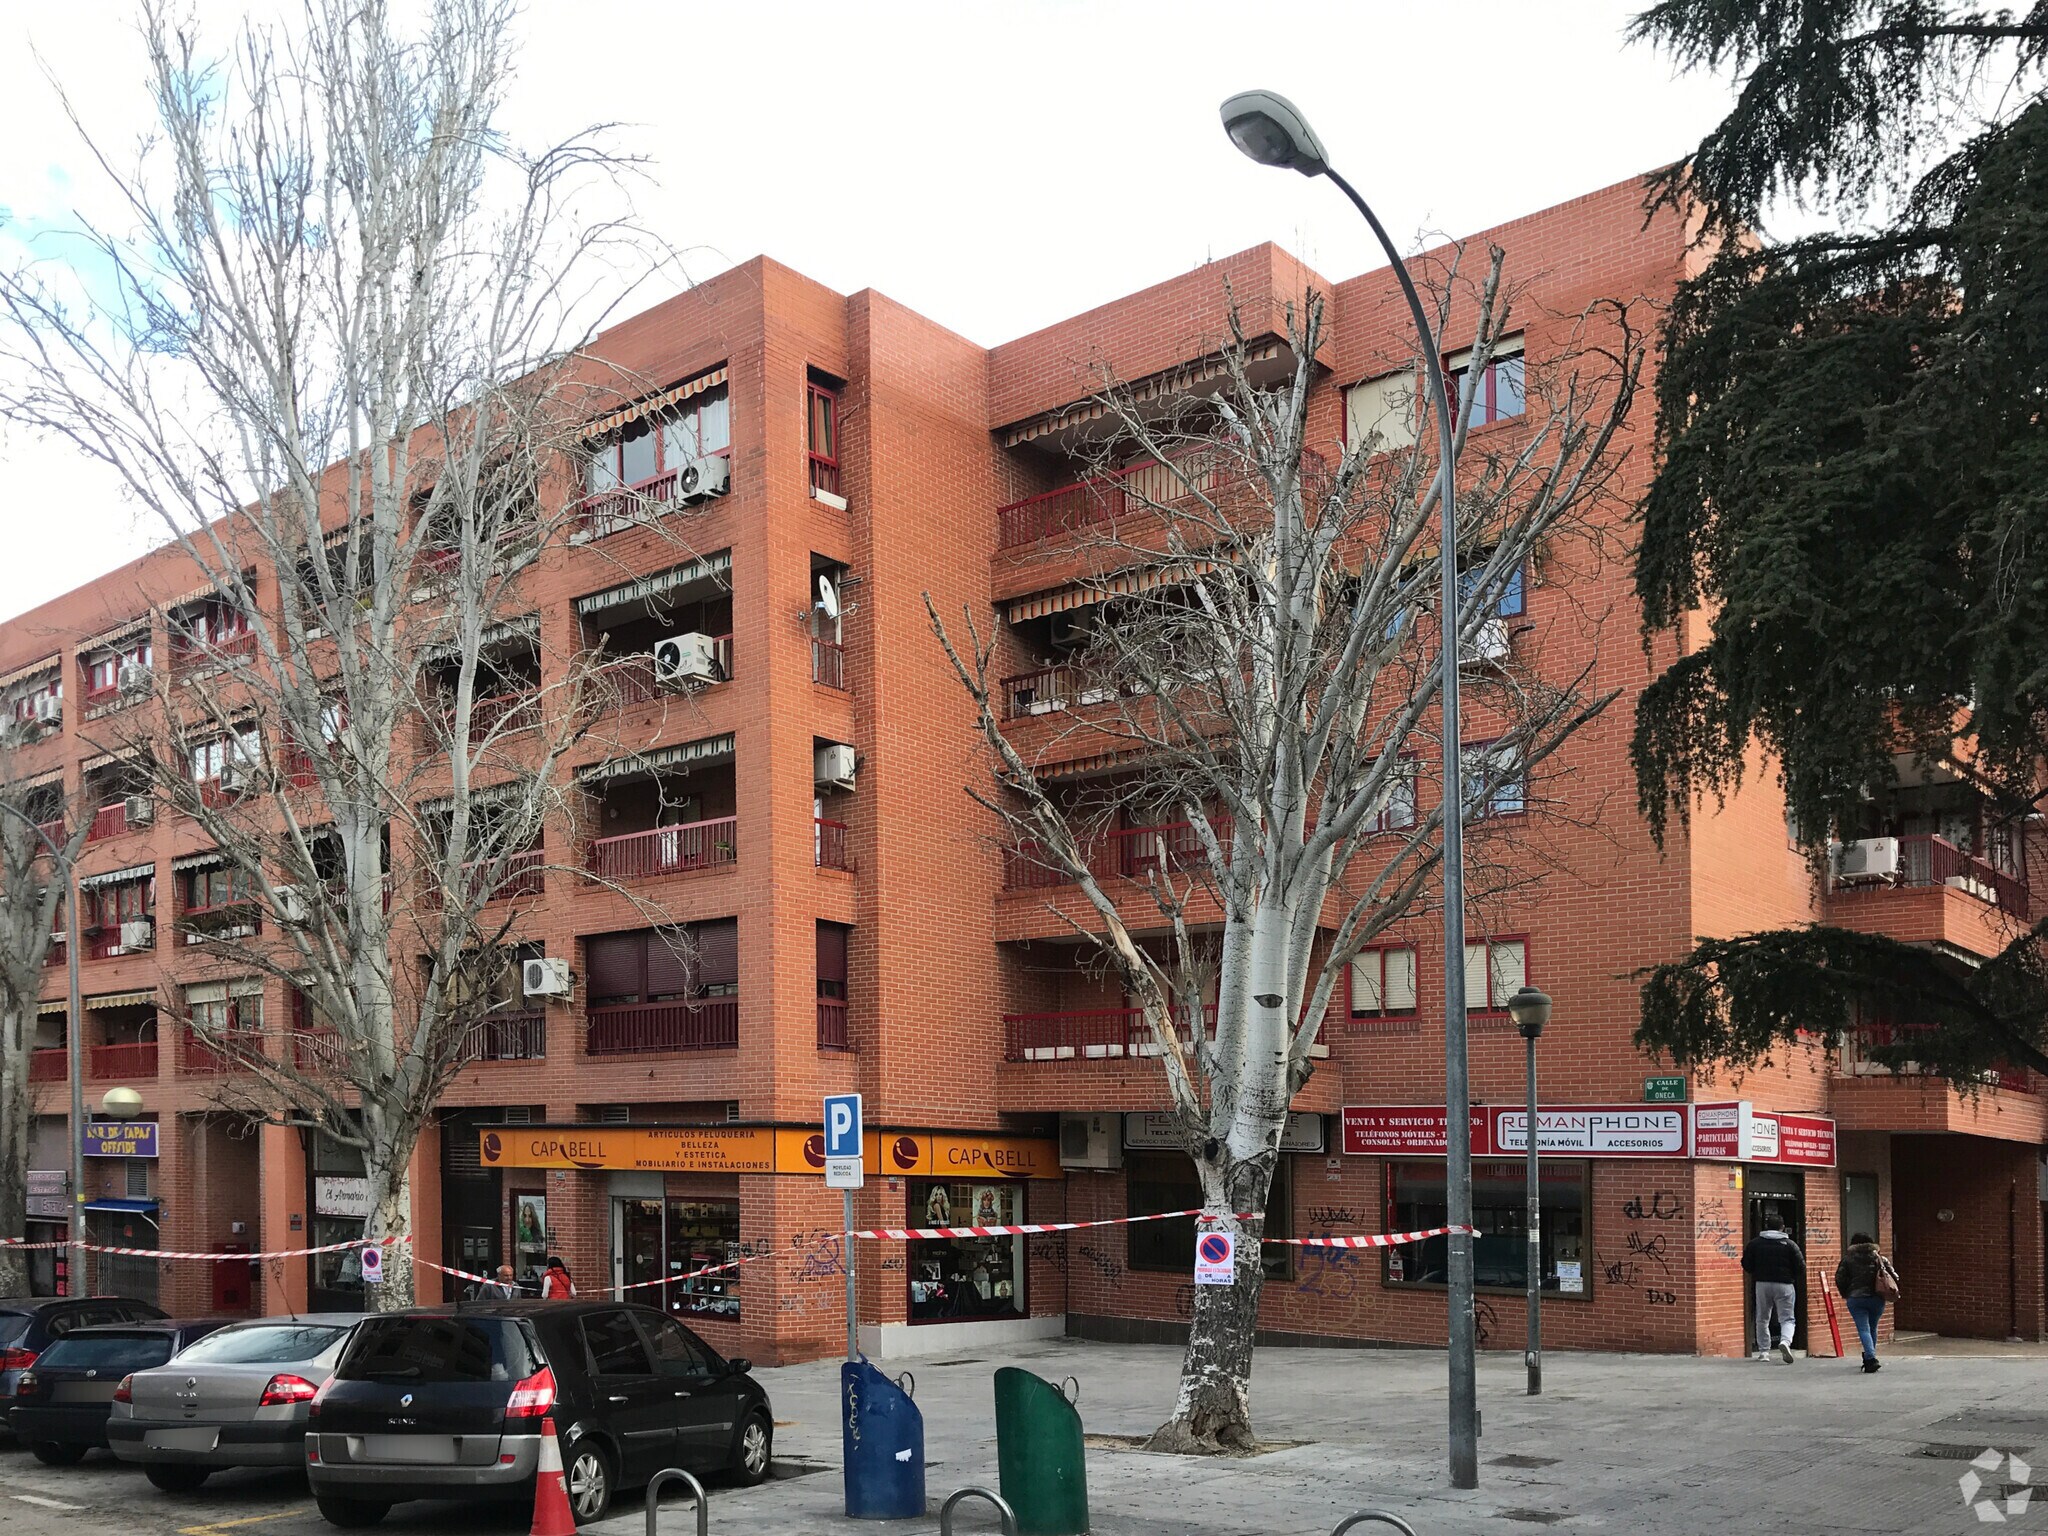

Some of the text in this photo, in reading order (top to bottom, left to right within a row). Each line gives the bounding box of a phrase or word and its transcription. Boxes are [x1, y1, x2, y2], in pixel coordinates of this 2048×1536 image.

[1654, 1091, 1676, 1099] ONECA
[1345, 1117, 1376, 1126] VENTA
[1379, 1117, 1386, 1126] Y
[1388, 1117, 1434, 1126] SERVICIO
[831, 1102, 852, 1151] P
[124, 1127, 151, 1140] TAPAS
[648, 1130, 755, 1139] ARTICULOS PELUQUERIA
[1355, 1129, 1399, 1138] TELÉFONOS
[1400, 1129, 1436, 1138] MÓVILES
[681, 1141, 719, 1149] BELLEZA
[1361, 1138, 1401, 1146] CONSOLAS
[1557, 1137, 1584, 1147] MÓVIL
[1607, 1139, 1663, 1147] ACCESORIOS
[101, 1141, 136, 1154] OFFSIDE
[684, 1151, 727, 1159] ESTETICA
[635, 1160, 770, 1169] MOBILIARIO E INSTALACIONES
[325, 1189, 364, 1201] El Armario
